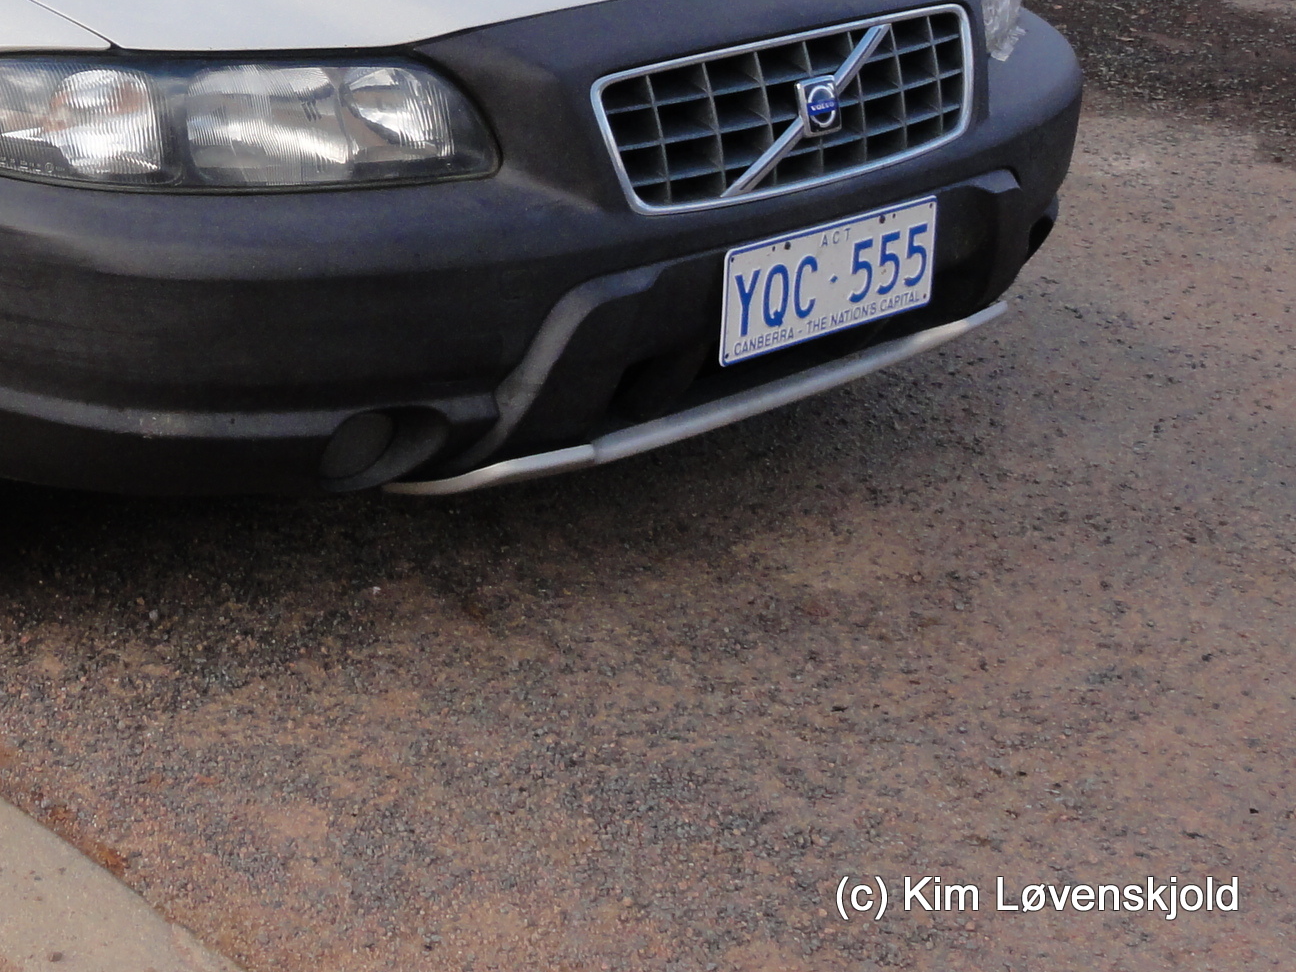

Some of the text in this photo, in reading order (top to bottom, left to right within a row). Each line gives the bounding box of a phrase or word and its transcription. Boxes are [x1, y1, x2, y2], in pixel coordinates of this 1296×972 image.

[810, 101, 835, 111] VOLVO
[821, 228, 851, 247] ACT
[735, 223, 928, 337] YQC 555
[734, 328, 794, 356] CANBERRA
[806, 317, 828, 334] THE
[879, 292, 920, 313] CAPITAL
